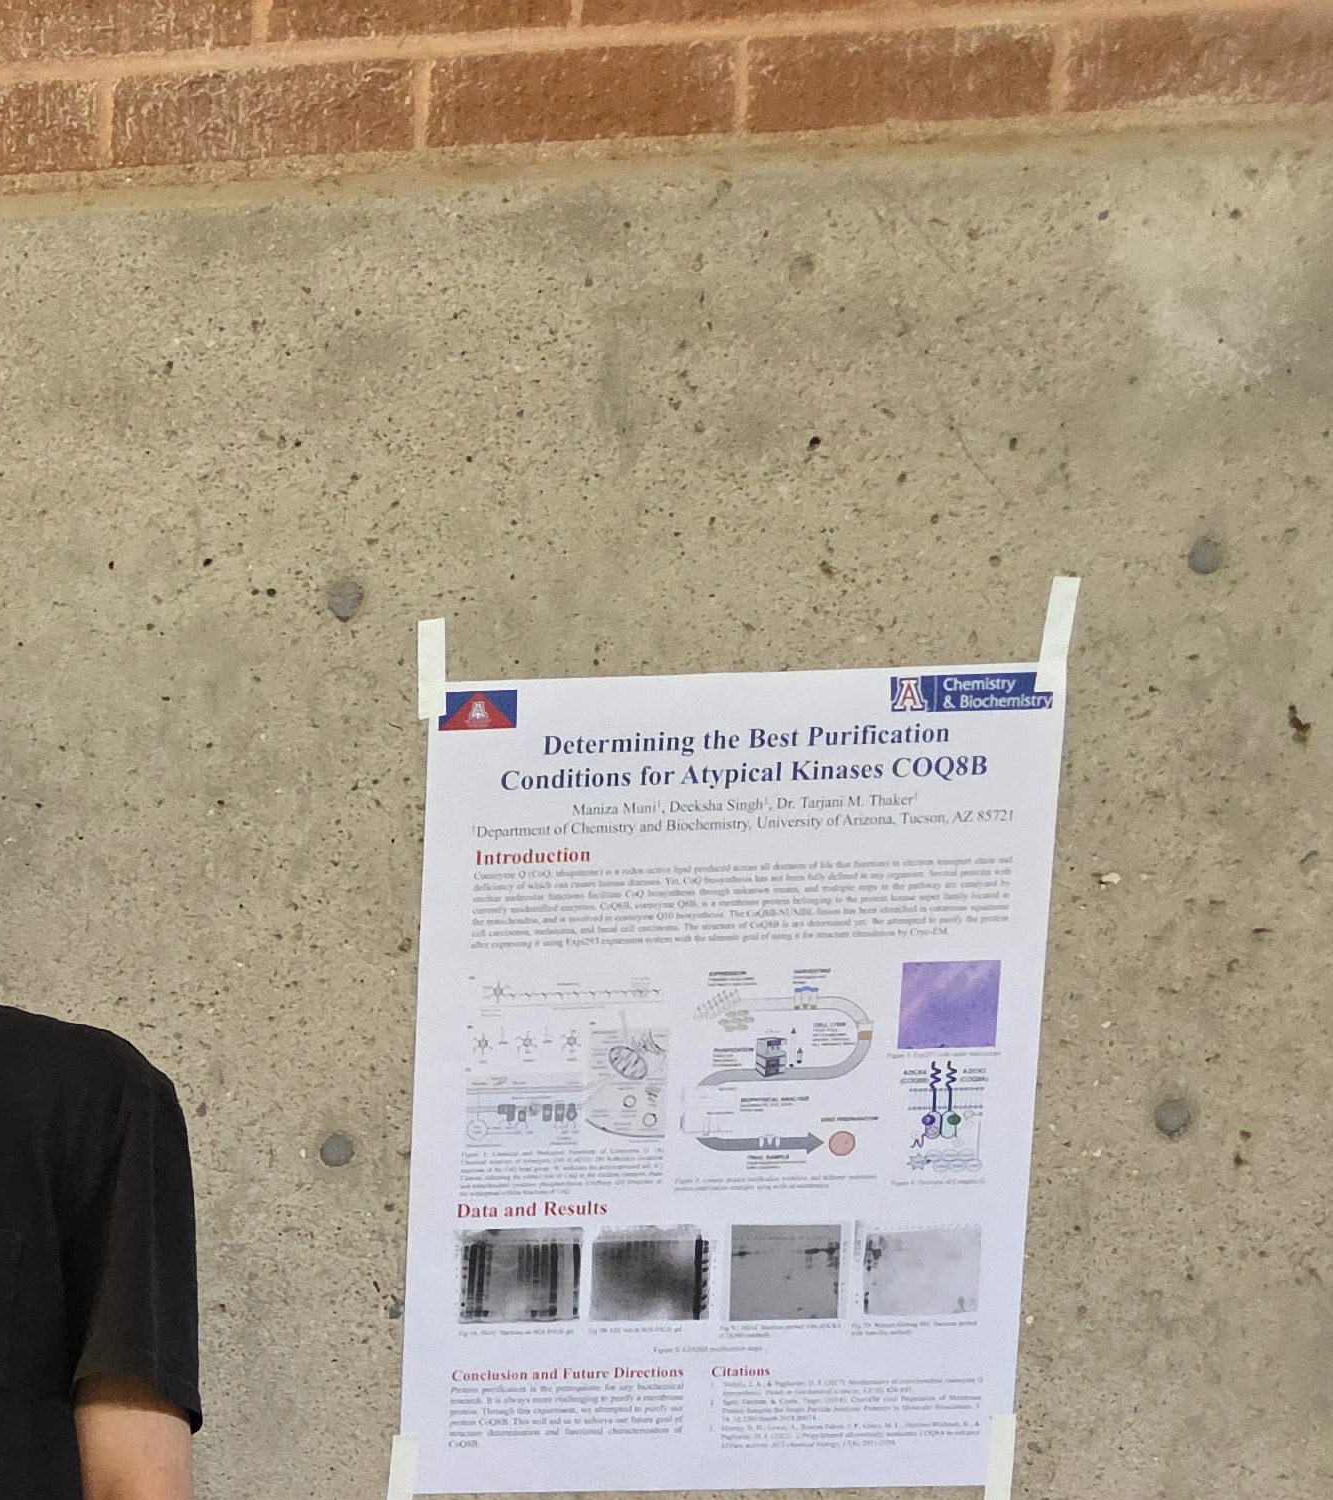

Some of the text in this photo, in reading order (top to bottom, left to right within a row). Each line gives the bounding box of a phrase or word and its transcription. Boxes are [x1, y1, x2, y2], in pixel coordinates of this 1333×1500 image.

[942, 675, 1016, 693] Chemistry
[942, 692, 1053, 710] & Biochemistry
[543, 723, 950, 756] Determining the Best Purification
[500, 754, 988, 791] Conditions for Atypical Kinases COQ8B
[572, 803, 619, 817] Maniza
[669, 799, 724, 813] Deeksha
[776, 797, 795, 810] Dr.
[801, 796, 844, 811] Tarjani
[847, 795, 865, 807] M.
[554, 822, 568, 835] of
[571, 820, 635, 836] Chemistry
[639, 820, 663, 833] and
[666, 816, 752, 833] Biochemistry,
[757, 814, 823, 831] University
[826, 813, 842, 827] of
[842, 812, 896, 826] Arizona,
[900, 811, 949, 825] Tucson,
[952, 810, 974, 822] AZ
[976, 809, 1014, 822] 85721
[475, 846, 591, 866] Introduction
[457, 1200, 608, 1218] Data and Results
[451, 1366, 684, 1382] Conclusion and Future Directions
[711, 1365, 771, 1378] Citations
